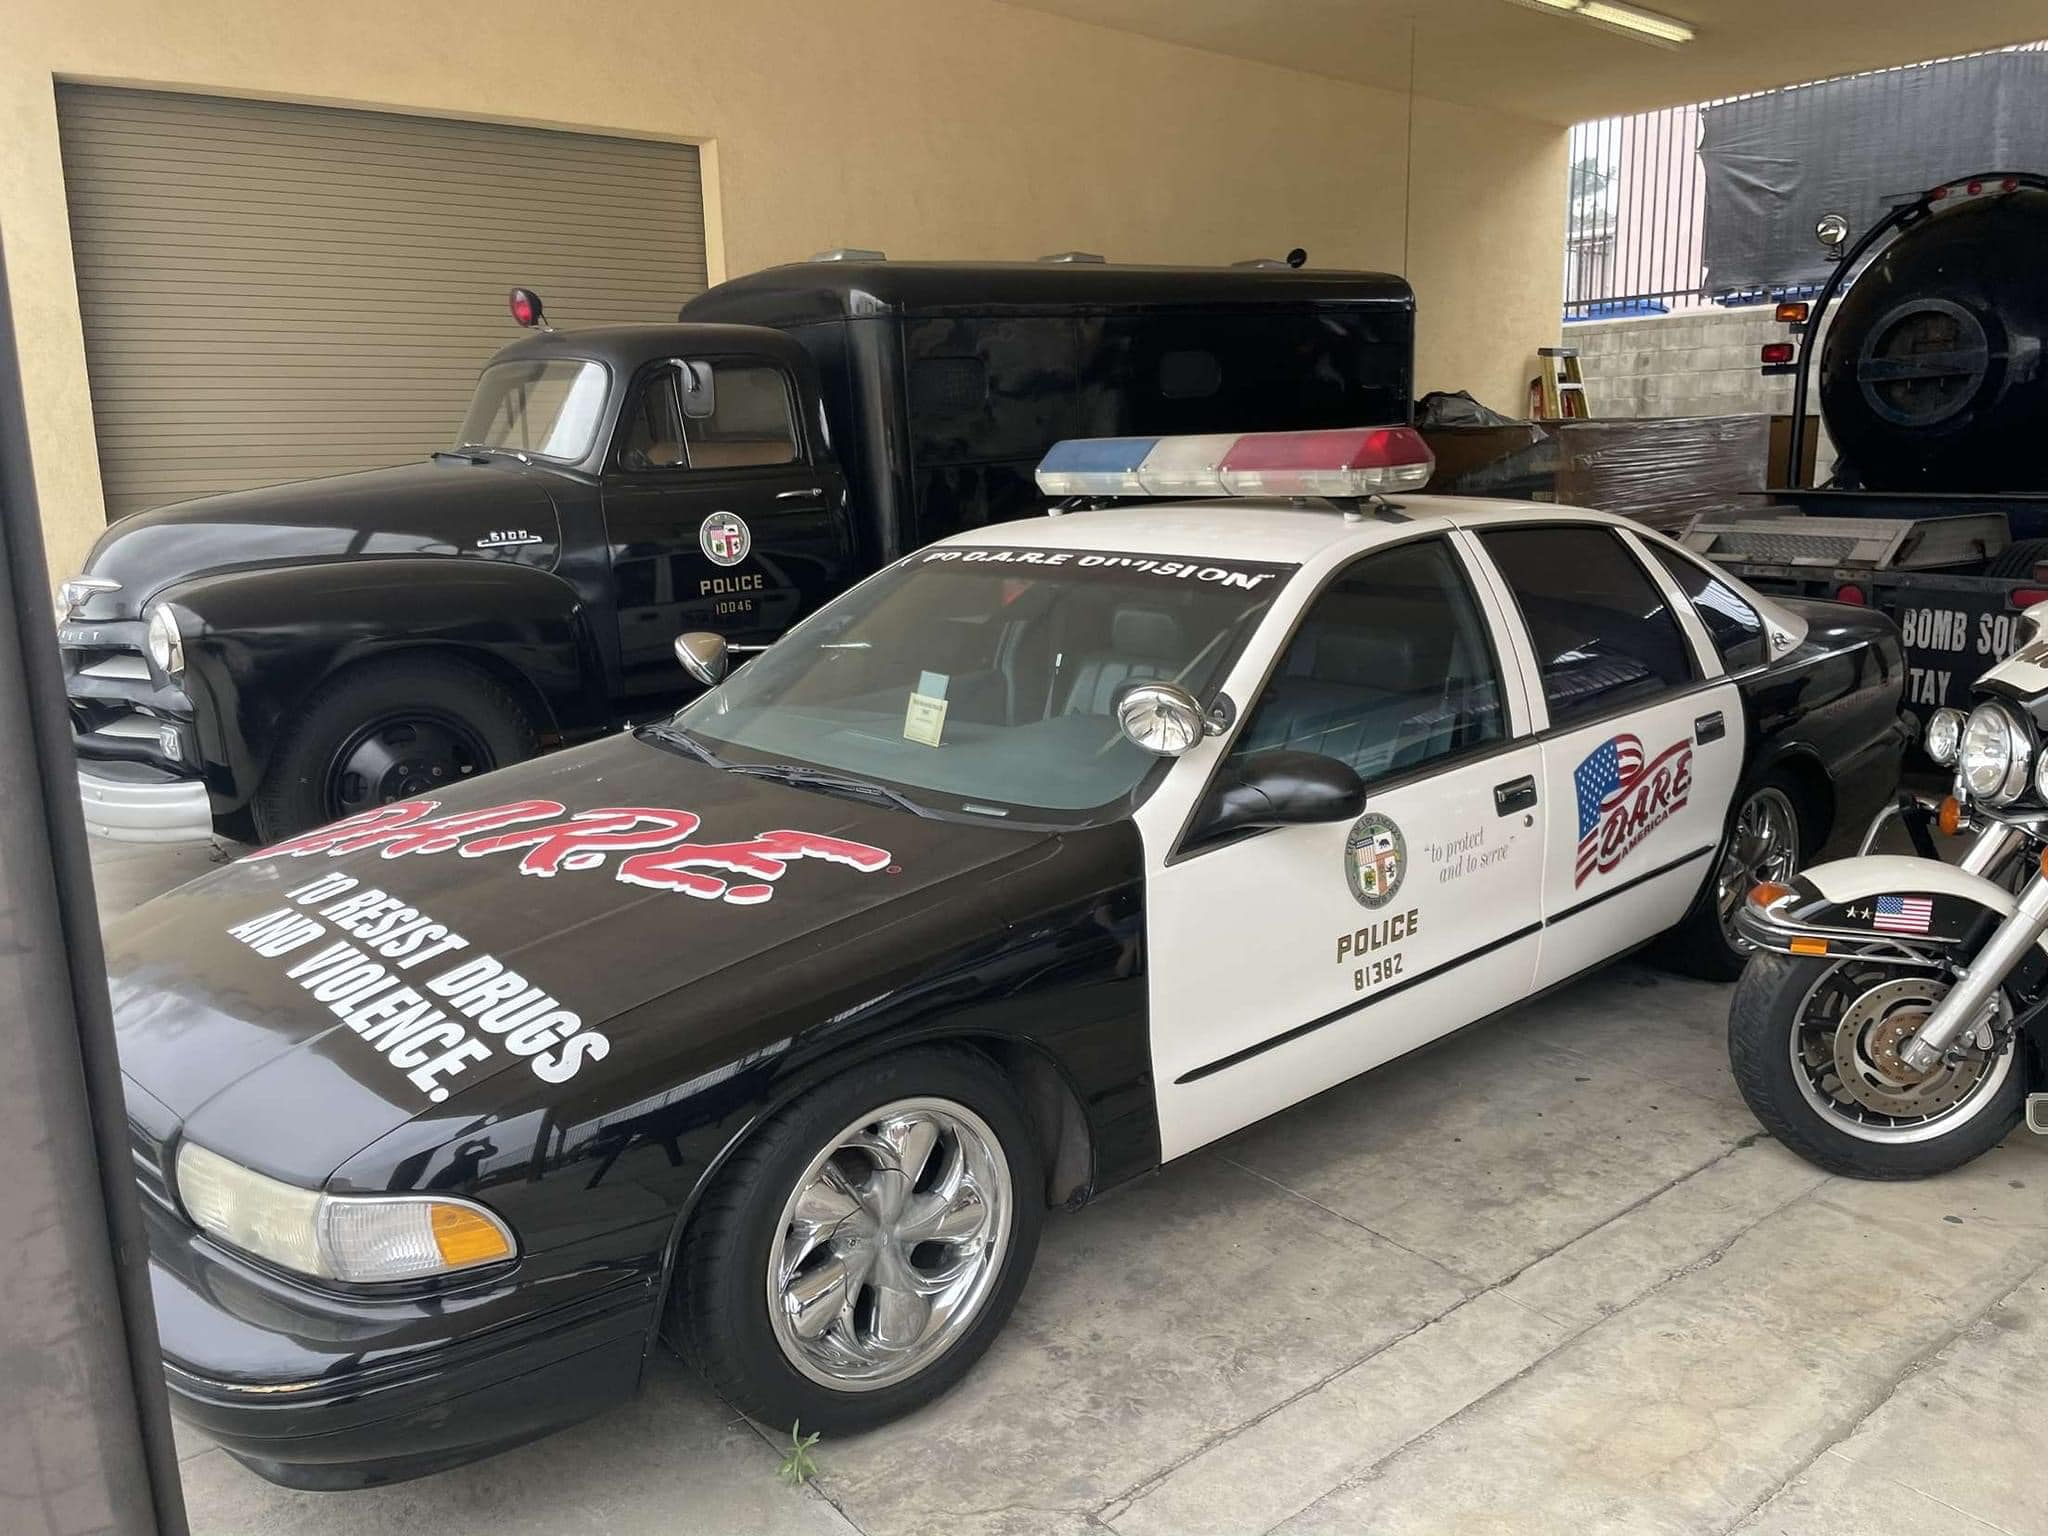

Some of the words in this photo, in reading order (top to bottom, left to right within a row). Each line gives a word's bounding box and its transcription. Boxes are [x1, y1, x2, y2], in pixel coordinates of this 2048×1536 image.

[700, 575, 763, 595] POLICE
[1078, 555, 1263, 590] DIVISION
[716, 600, 752, 615] 10046
[1902, 608, 1968, 651] BOMB
[1977, 612, 2018, 663] SQU
[1910, 667, 1952, 706] TAY
[1446, 825, 1484, 863] protect
[1622, 810, 1669, 860] AMERICA
[1439, 854, 1463, 883] and
[1467, 854, 1478, 873] to
[285, 872, 359, 905] TO
[318, 888, 471, 970] RESIST
[1337, 908, 1419, 964] POLICE
[1354, 952, 1403, 992] 81382
[226, 907, 327, 958] AND
[286, 940, 493, 1103] VIOLENCE.
[424, 953, 611, 1084] DRUGS
